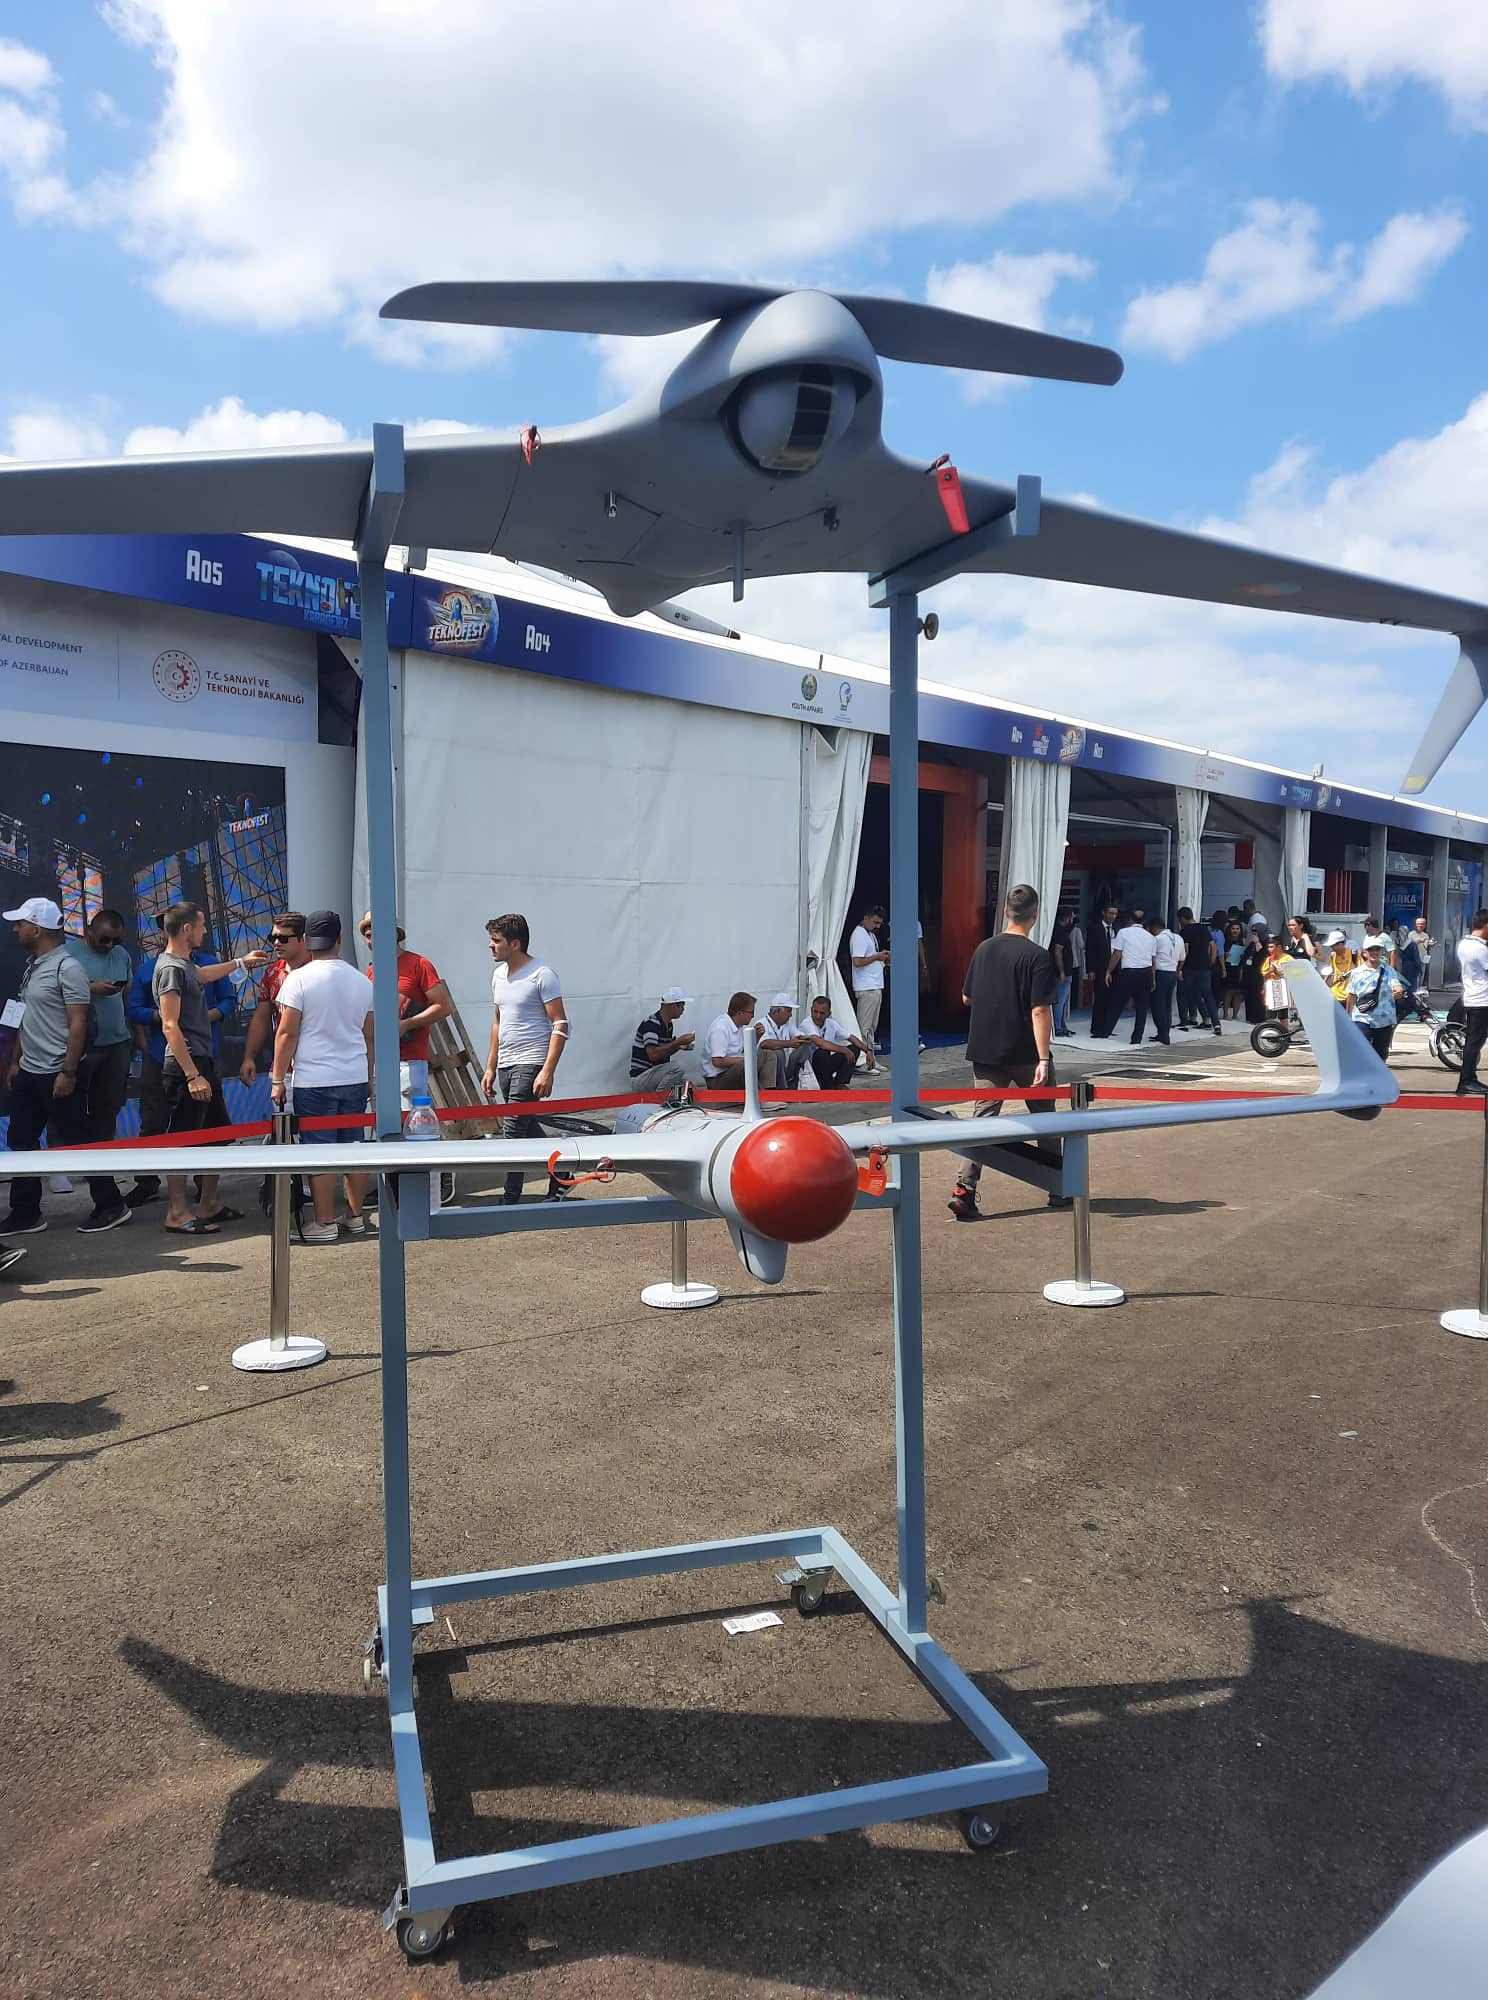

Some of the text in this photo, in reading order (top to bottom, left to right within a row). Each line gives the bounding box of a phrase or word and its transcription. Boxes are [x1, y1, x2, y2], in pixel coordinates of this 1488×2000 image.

[186, 549, 223, 586] A05
[429, 622, 487, 642] TEKNOFEST
[525, 624, 551, 653] A04
[0, 633, 83, 654] AL DEVELOPMENT
[12, 660, 69, 676] AZERBAIJAN
[206, 682, 256, 698] TEKNOLOJİ
[223, 673, 257, 687] SANAYİ
[258, 679, 270, 688] VE
[229, 813, 270, 833] TEKNOFEST
